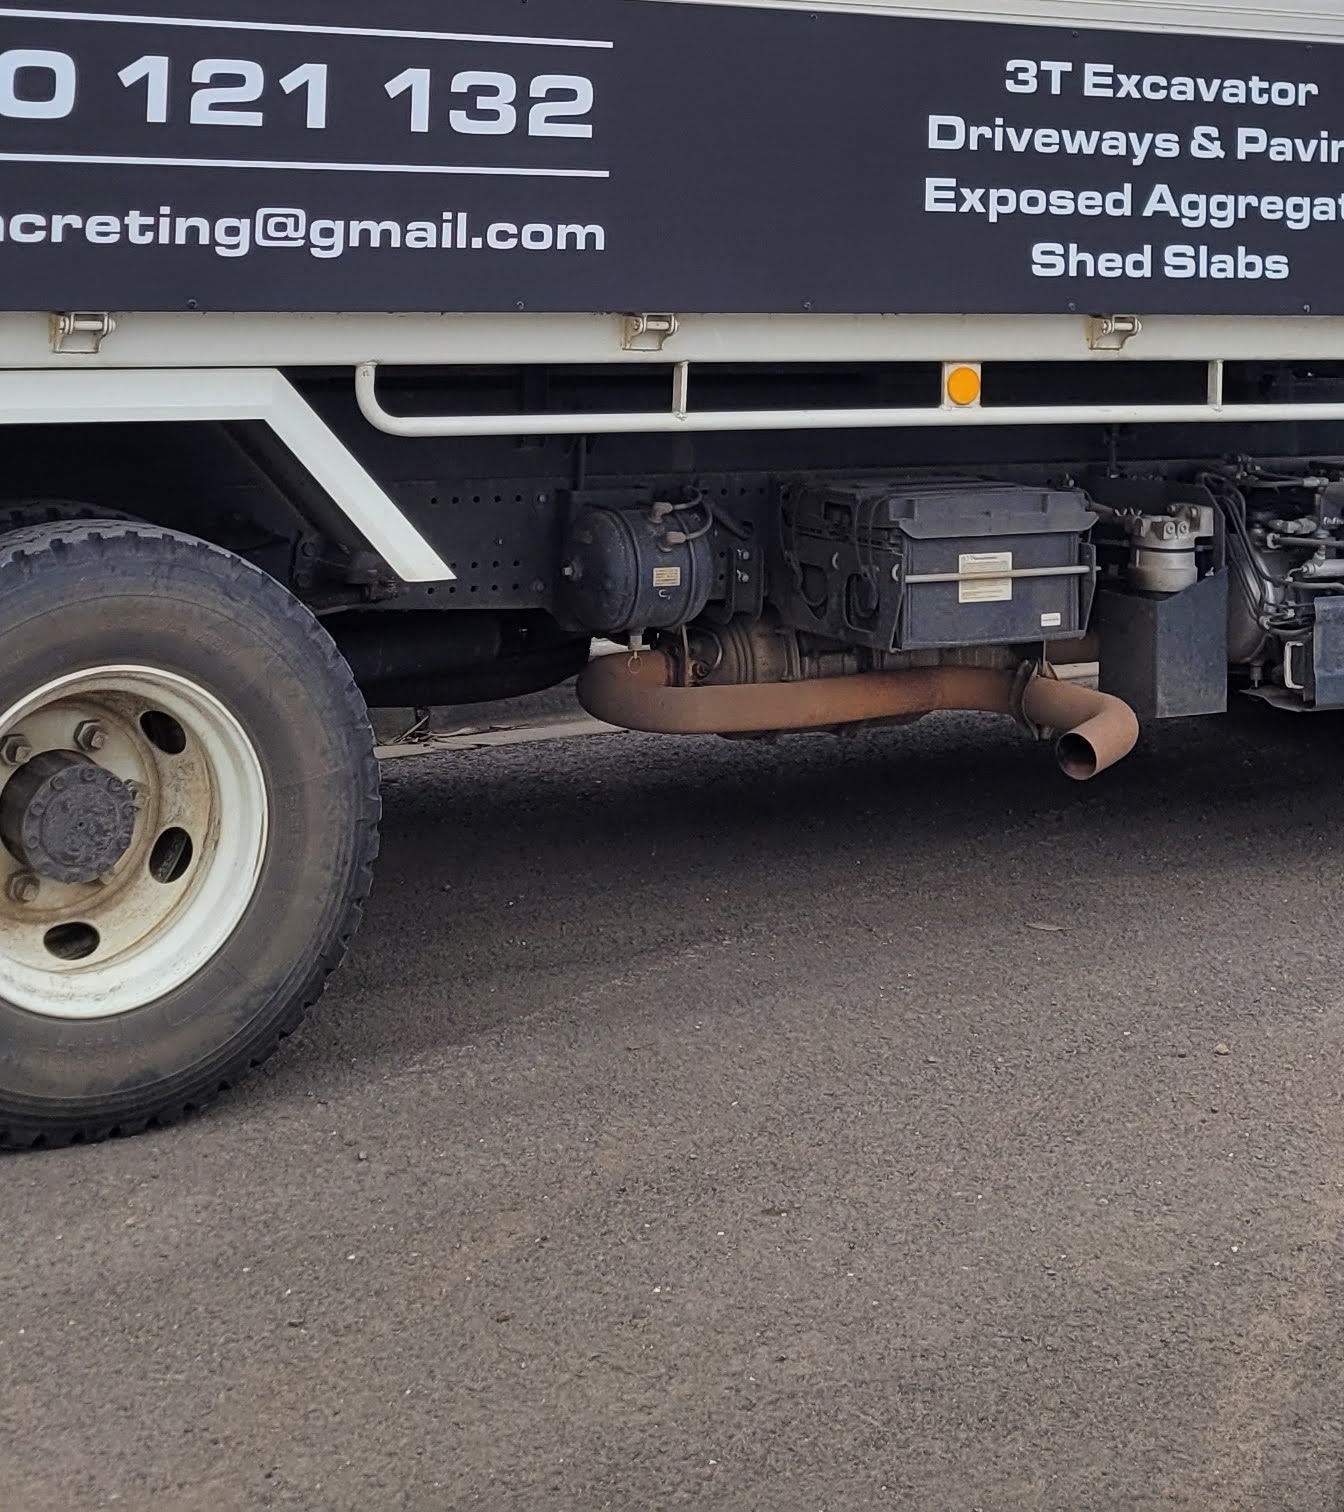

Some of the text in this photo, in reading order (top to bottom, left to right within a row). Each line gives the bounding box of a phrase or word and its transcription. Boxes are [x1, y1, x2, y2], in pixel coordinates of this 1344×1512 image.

[116, 55, 329, 129] 121
[382, 67, 595, 139] 132
[1005, 59, 1320, 107] 3T Excavator
[928, 114, 1181, 167] Driveways
[1190, 125, 1227, 160] &
[924, 177, 1133, 224] Exposed
[1031, 242, 1291, 280] Shed Slabs
